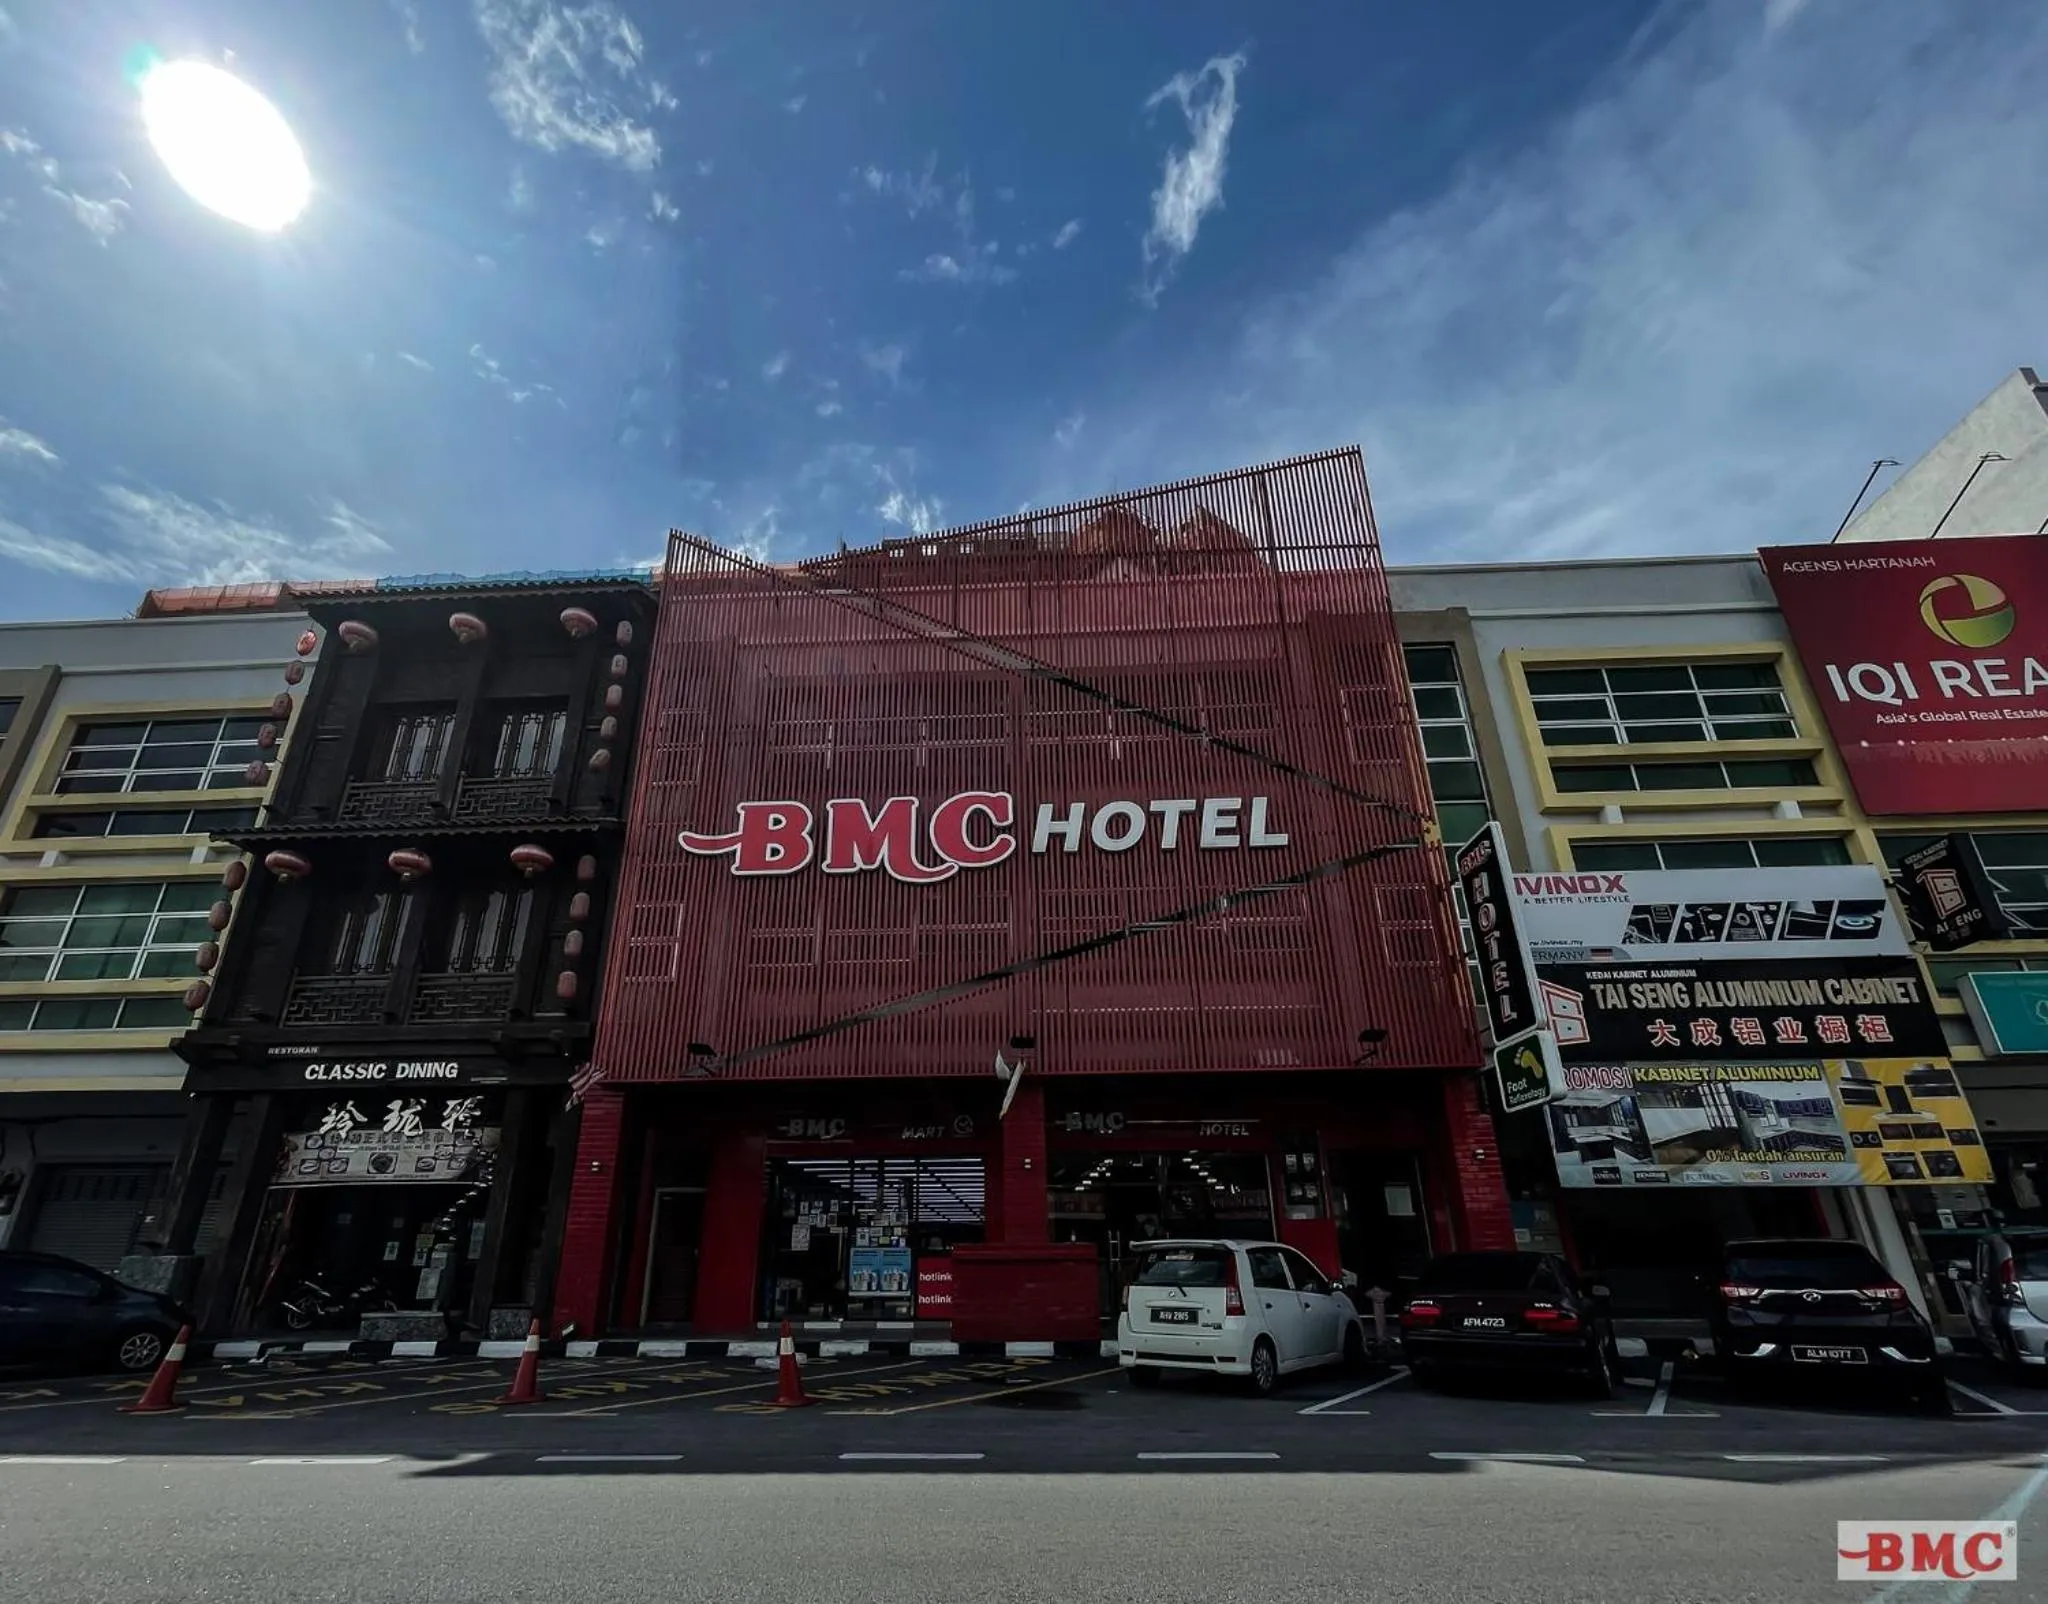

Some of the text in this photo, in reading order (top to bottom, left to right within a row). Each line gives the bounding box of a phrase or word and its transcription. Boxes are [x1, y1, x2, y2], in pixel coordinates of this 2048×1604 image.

[1782, 556, 1936, 573] AGENSI HARTANAH
[1825, 661, 1920, 706] IQI
[1876, 712, 1918, 725] Asia's
[1920, 710, 1967, 724] Global
[1970, 709, 2002, 721] Real
[678, 791, 1289, 883] BMC HOTEL
[1459, 839, 1492, 874] BMC
[1513, 874, 1628, 896] IVINOX
[1579, 895, 1630, 903] LIFESTYLE
[1471, 871, 1518, 1024] HOTEL
[1531, 951, 1584, 960] ERMANY
[1585, 969, 1697, 980] KEDAI KABINET ALUMINIUM
[1589, 976, 1920, 1010] TAI SENG ALUMINIUM CABINET
[1646, 1013, 1894, 1047] 大成铝业橱柜
[304, 1062, 459, 1080] CLASSIC DINING
[1561, 1065, 1820, 1089] ROMOSI KABINET ALUMINIUM
[1507, 1077, 1528, 1094] Foot
[777, 1116, 846, 1140] BMC
[1200, 1124, 1249, 1137] HOTEL
[1785, 1150, 1844, 1163] ansuran
[919, 1272, 952, 1281] hotlink
[918, 1295, 952, 1304] hotlink
